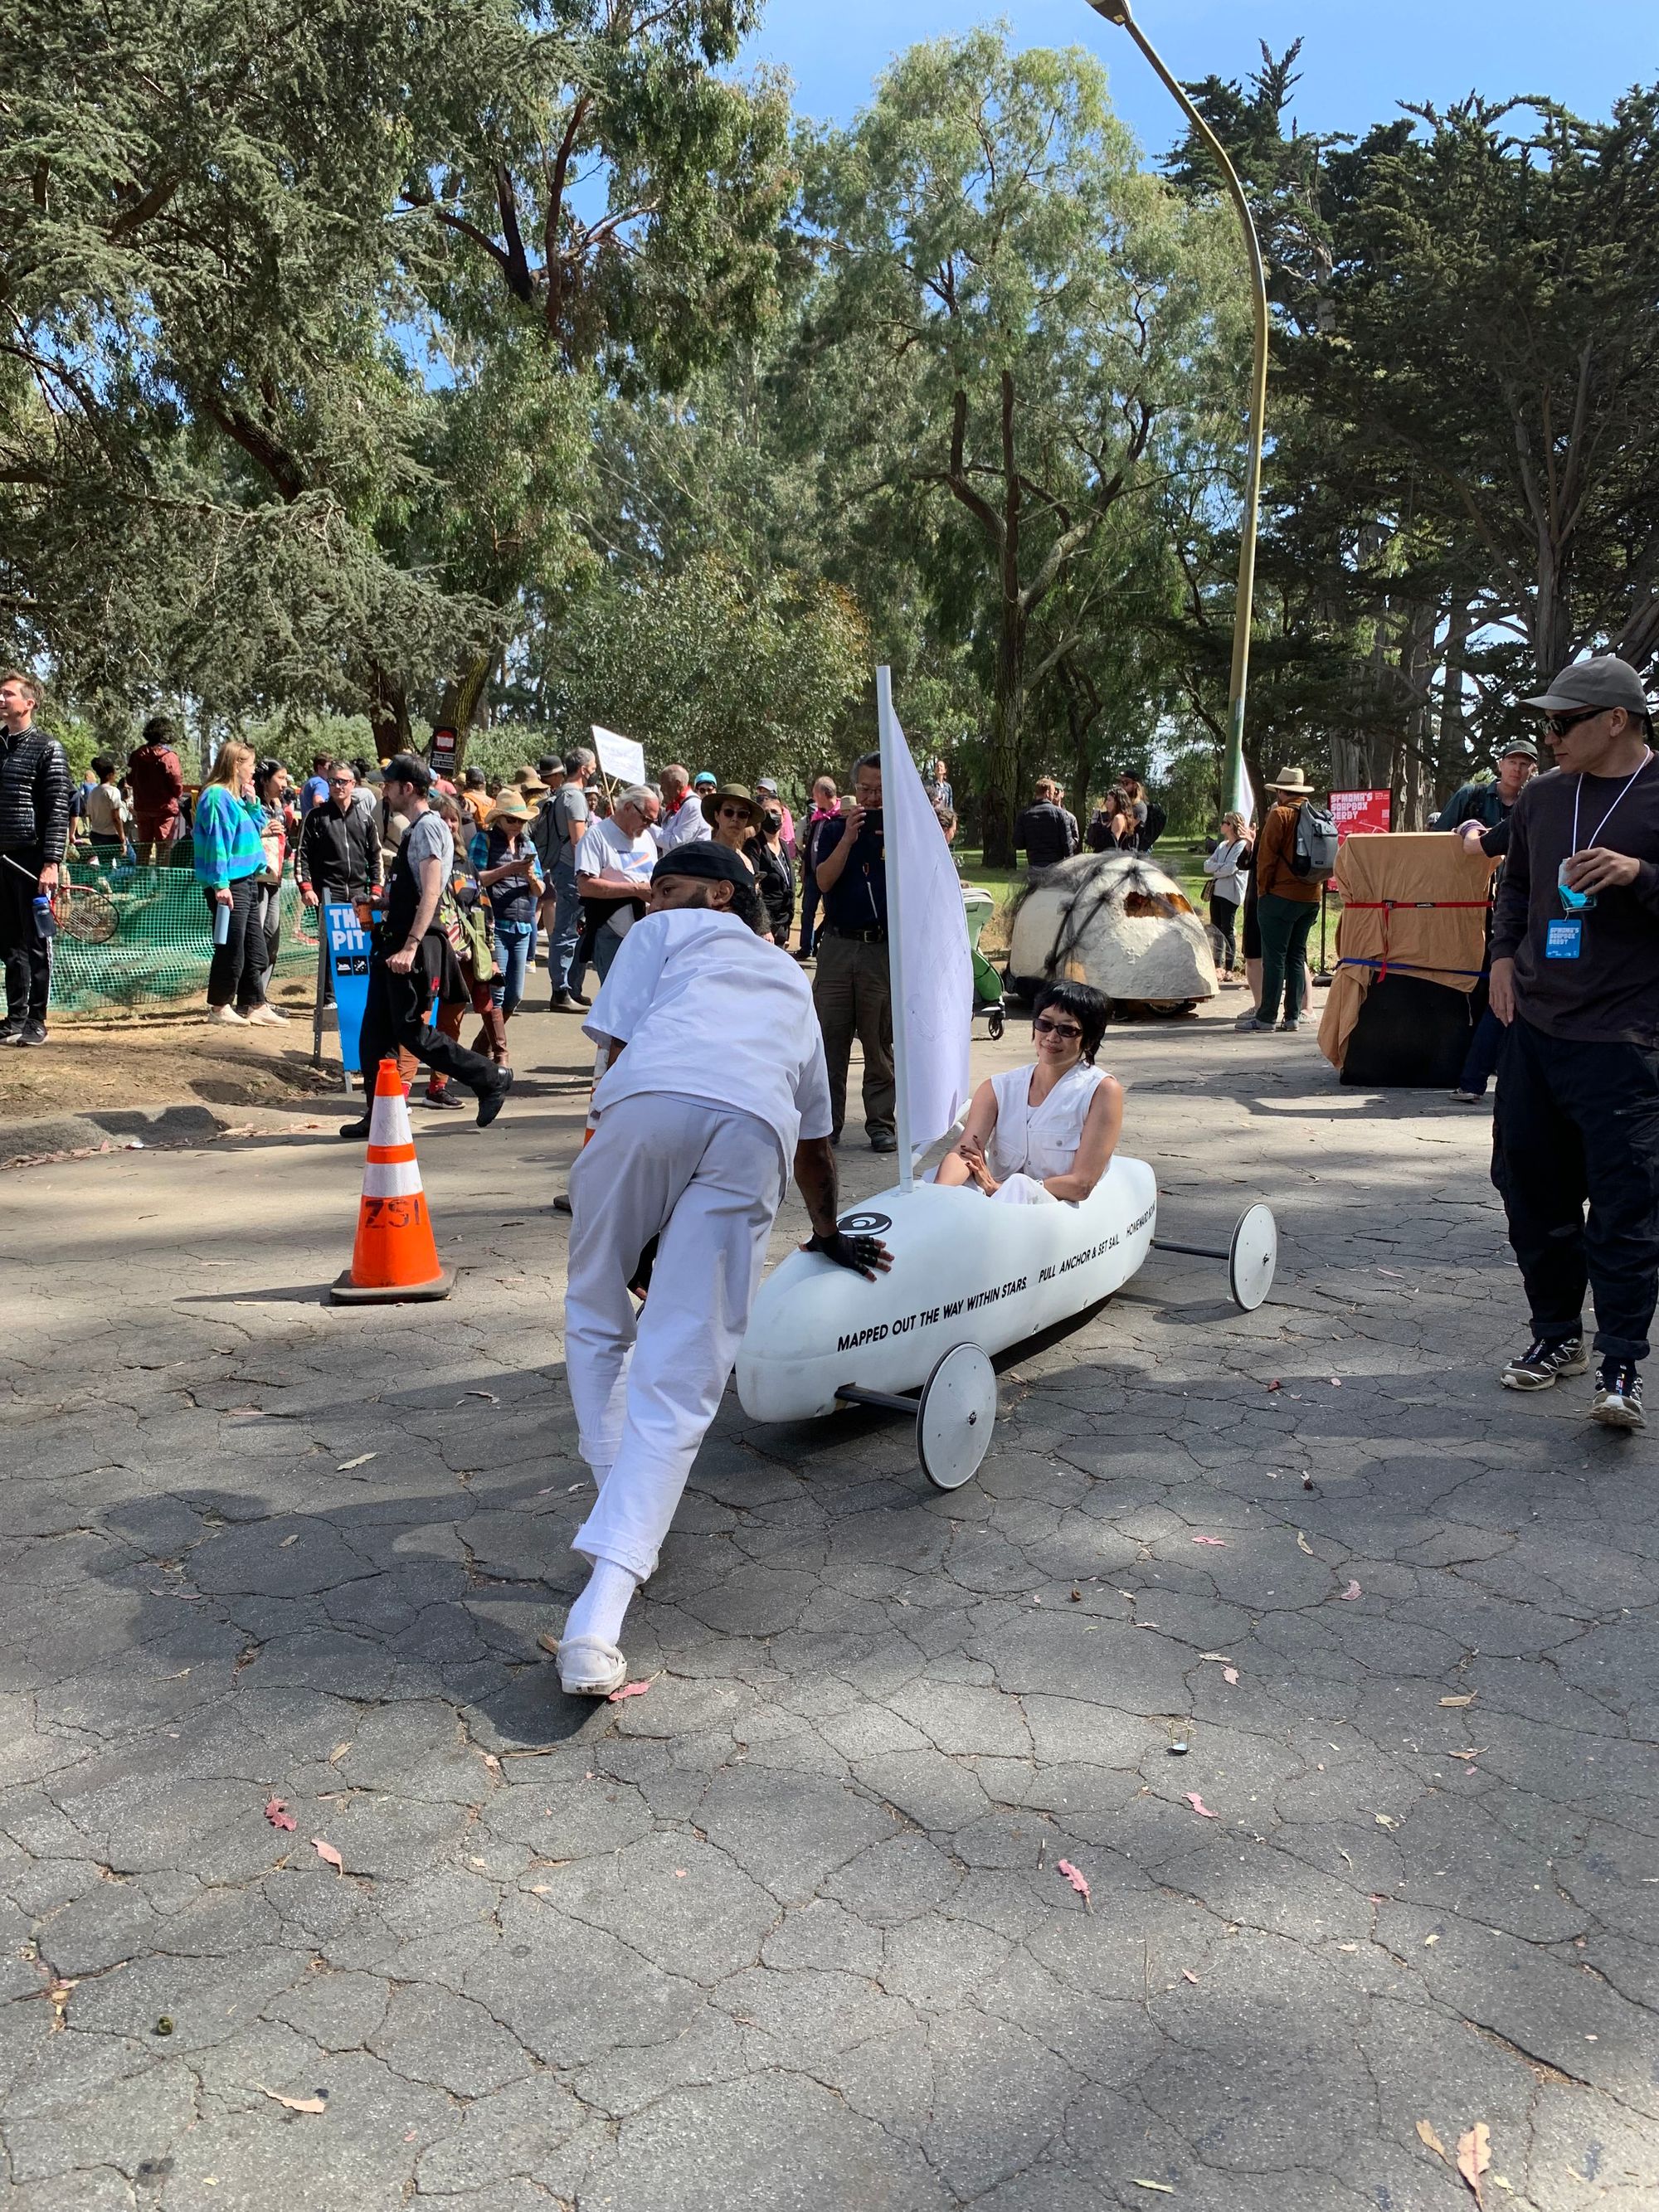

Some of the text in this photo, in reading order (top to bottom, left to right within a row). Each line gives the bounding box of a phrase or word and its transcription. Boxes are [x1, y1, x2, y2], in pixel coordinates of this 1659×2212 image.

[1331, 792, 1373, 803] SFMOMA'S
[1331, 802, 1368, 811] SOAPBOX
[1331, 810, 1359, 820] DERBY
[332, 930, 366, 951] PIT
[1039, 1264, 1056, 1283] PULL
[1058, 1249, 1091, 1274] ANCHOR
[1092, 1247, 1097, 1259] &
[1097, 1239, 1108, 1256] SET
[837, 1325, 888, 1352] MAPPED
[892, 1315, 917, 1335] OUT
[920, 1307, 940, 1327] THE
[943, 1299, 965, 1319] WAY
[967, 1286, 1000, 1311] WITHIN
